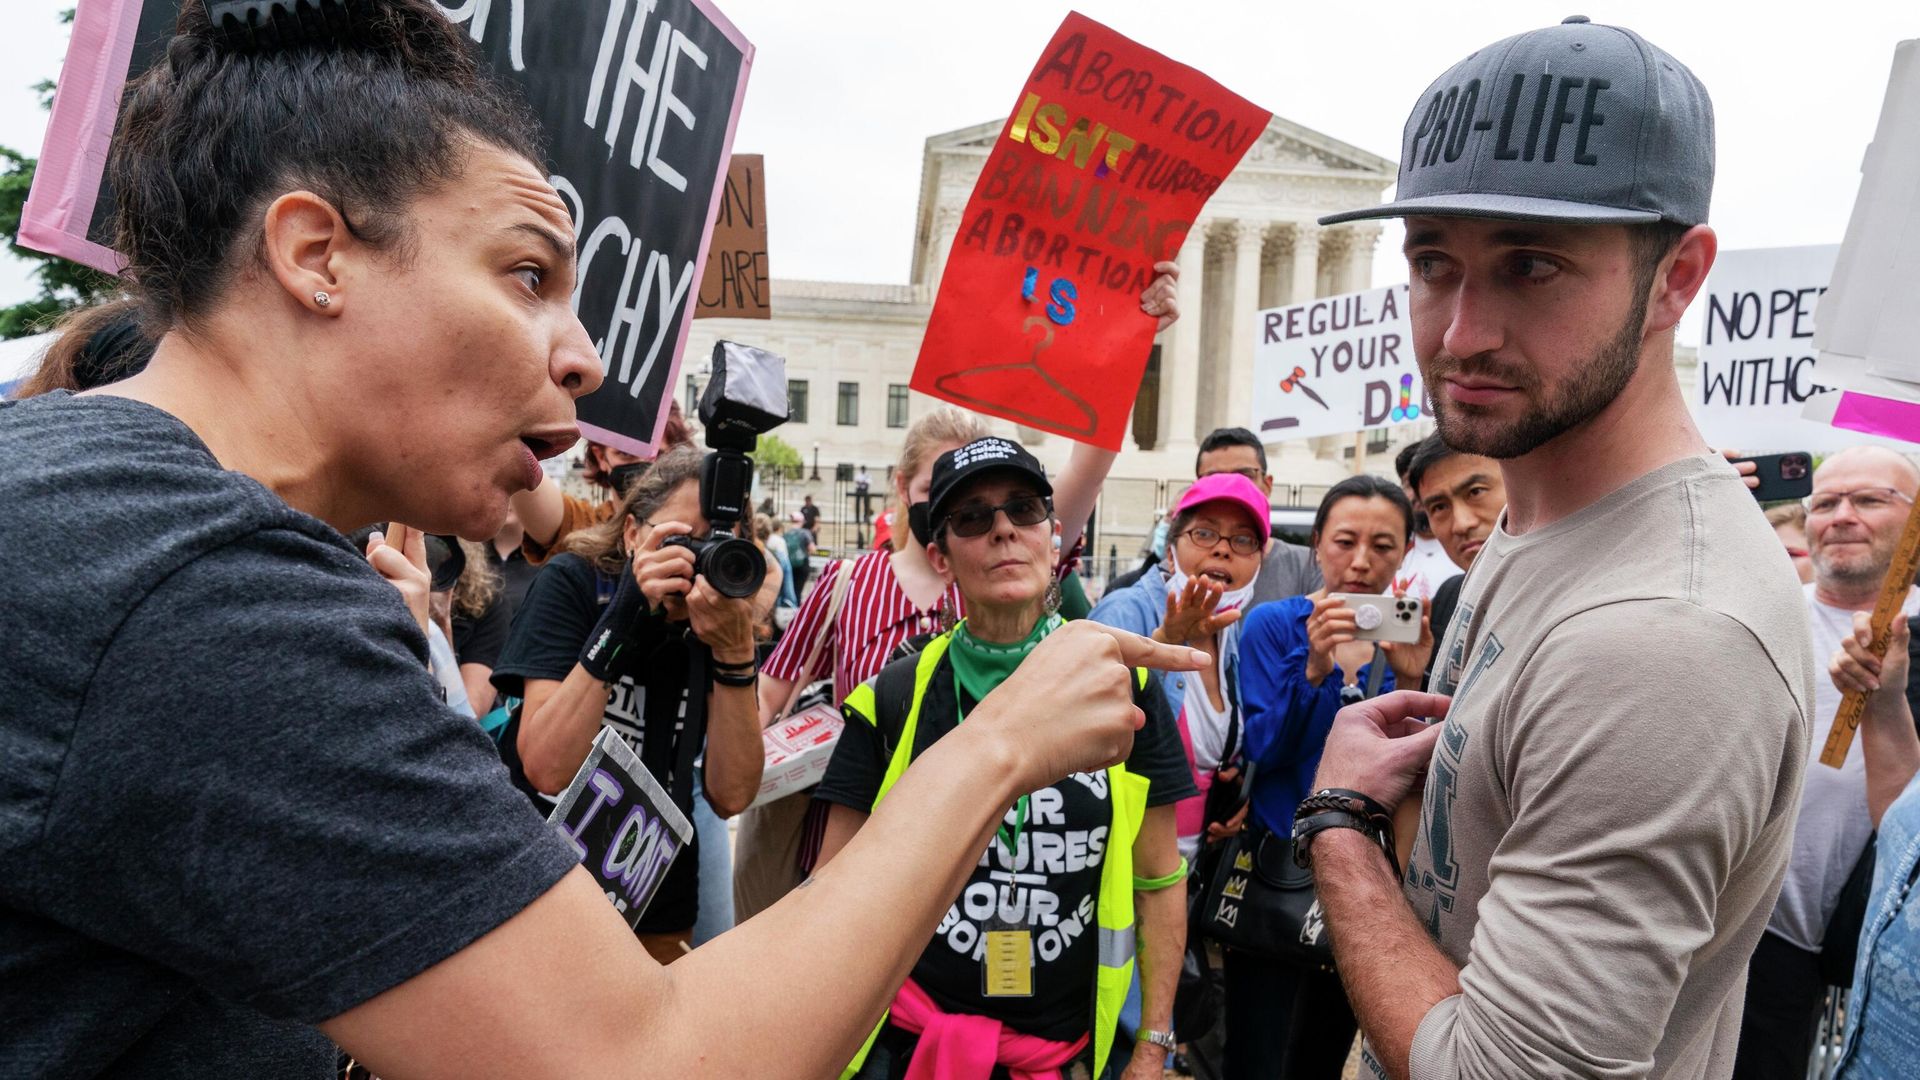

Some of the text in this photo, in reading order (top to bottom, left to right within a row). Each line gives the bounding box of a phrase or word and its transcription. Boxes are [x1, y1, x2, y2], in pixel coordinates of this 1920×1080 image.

[584, 0, 709, 192] THE
[1034, 32, 1249, 154] ABORTION
[1408, 73, 1612, 172] PRO-LIFE
[1120, 142, 1223, 200] MURDER
[981, 151, 1192, 259] BANNING
[964, 208, 1154, 295] ABORTION
[1022, 266, 1078, 326] IS
[1264, 285, 1410, 344] REGULA
[1706, 287, 1827, 345] NO PE
[1311, 334, 1402, 378] YOUR
[970, 444, 1018, 455] cuidado
[964, 882, 1060, 927] OUR
